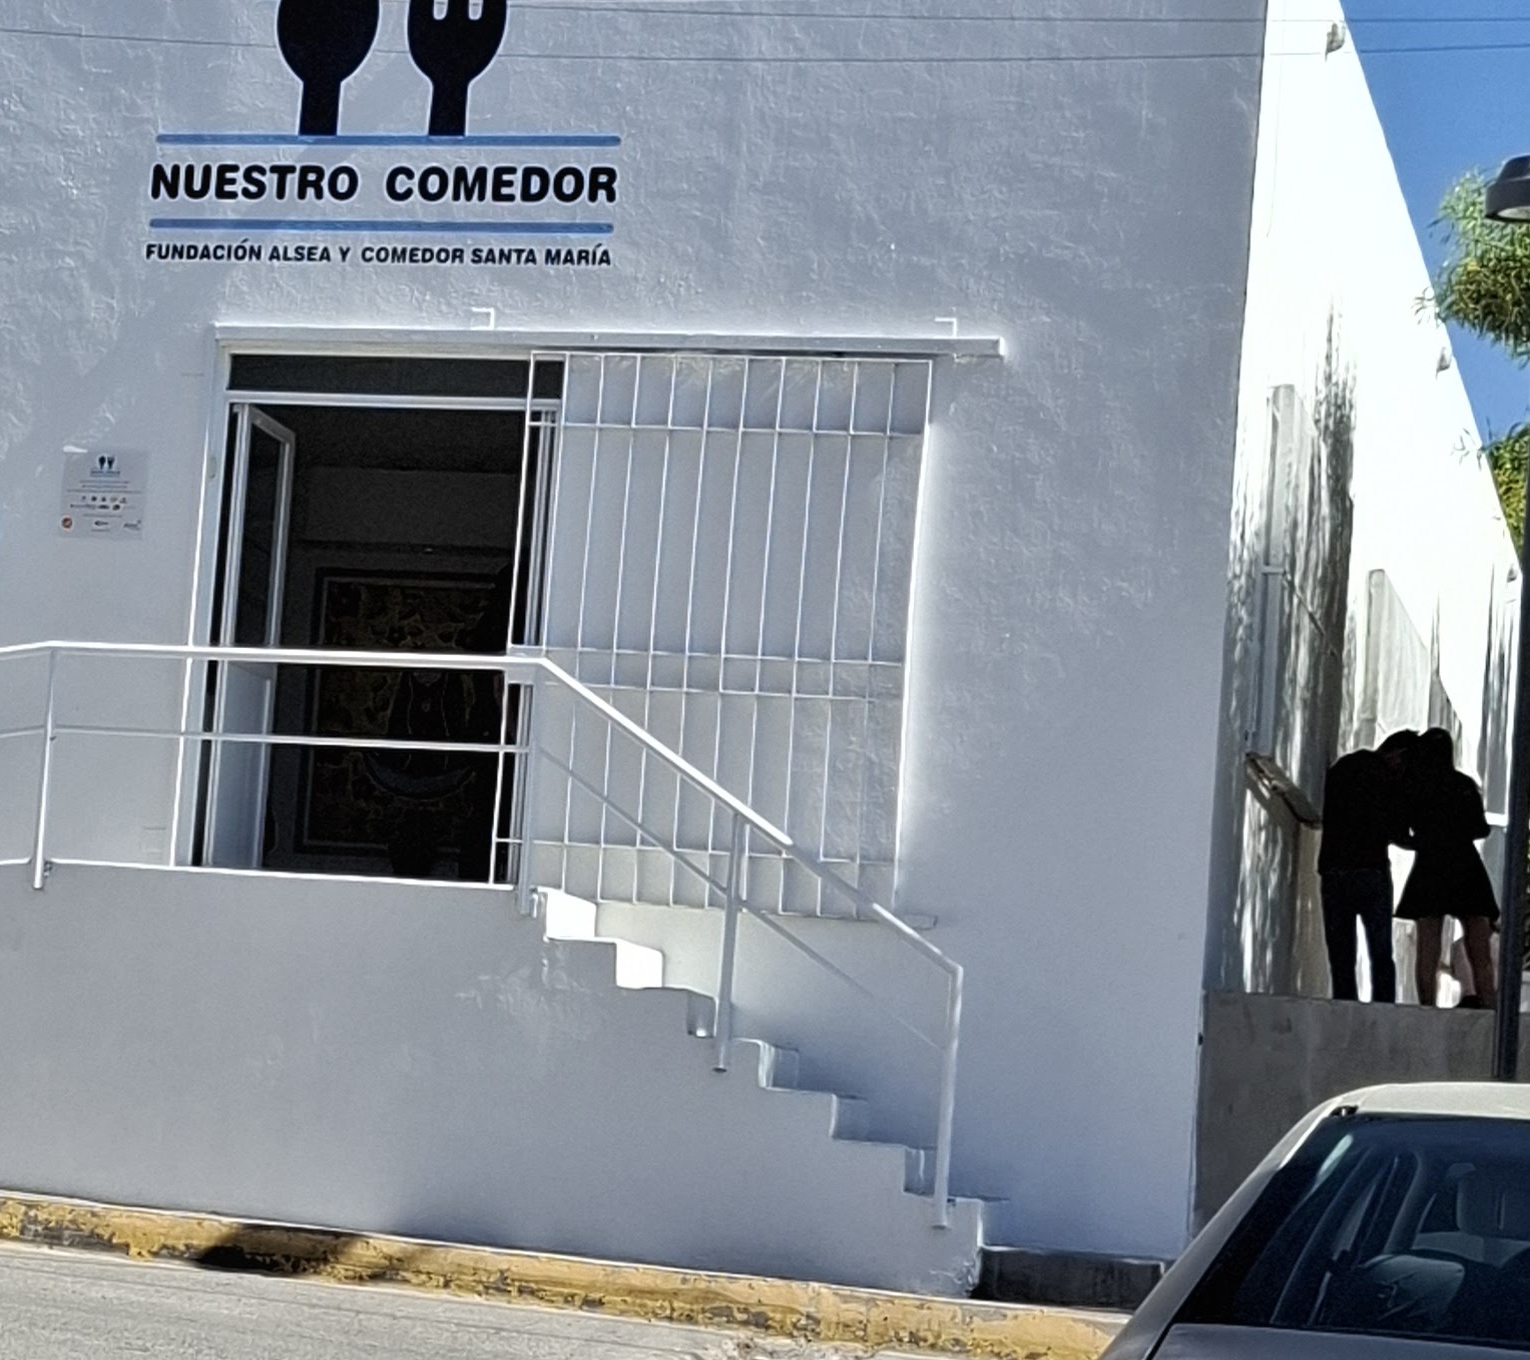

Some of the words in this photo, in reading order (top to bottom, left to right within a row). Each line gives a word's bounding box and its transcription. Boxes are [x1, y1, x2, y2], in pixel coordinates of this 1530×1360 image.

[151, 163, 359, 201] NUESTRO
[385, 165, 618, 203] COMEDOR
[145, 238, 262, 263] FUNDACIÓN
[268, 245, 332, 263] ALSEA
[338, 246, 351, 263] Y
[361, 246, 465, 265] COMEDOR
[470, 247, 538, 266] SANTA
[544, 242, 612, 267] MARÍA
